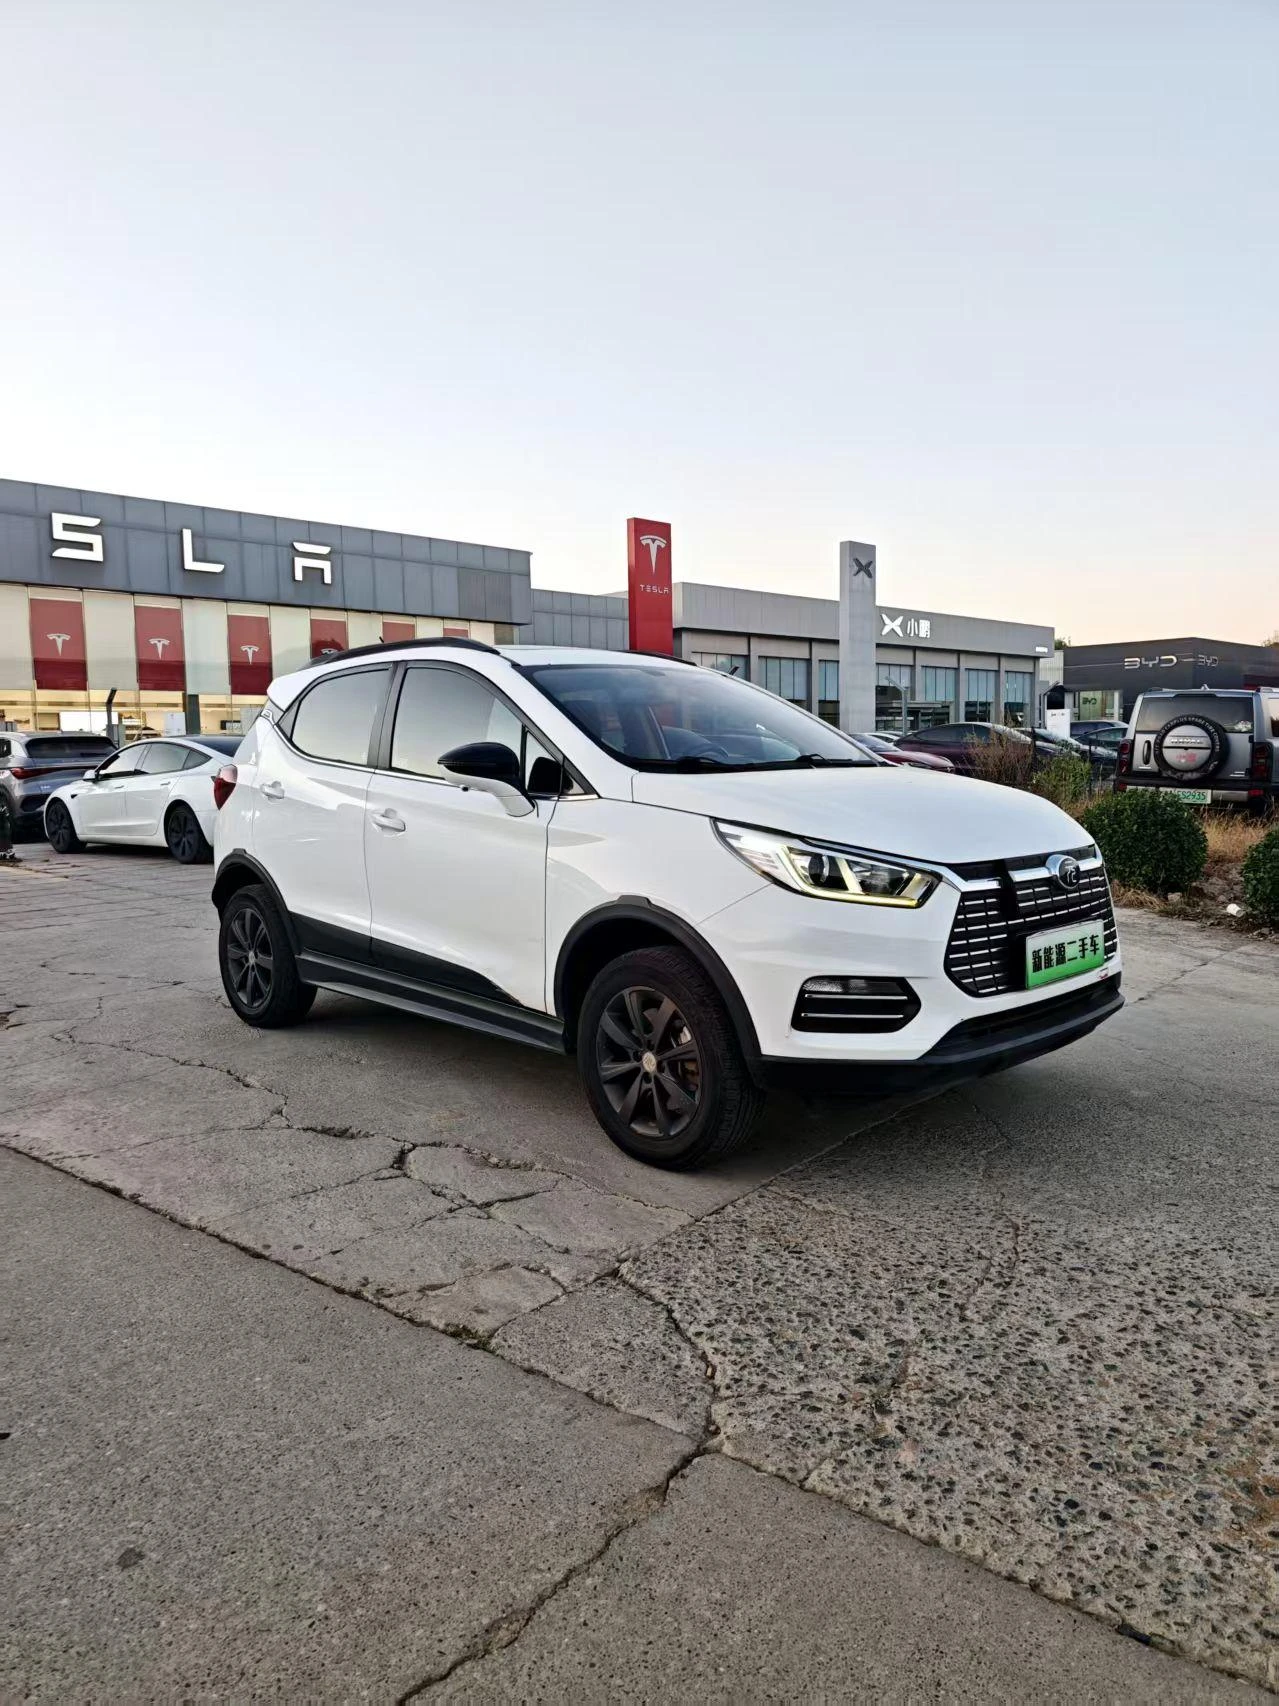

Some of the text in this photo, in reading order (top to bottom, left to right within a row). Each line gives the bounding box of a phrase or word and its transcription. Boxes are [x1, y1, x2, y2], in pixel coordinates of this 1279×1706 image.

[639, 584, 669, 594] TESLA
[1124, 655, 1177, 668] BYD
[1198, 654, 1219, 667] BYD
[1032, 934, 1100, 973] 新能源二手车
